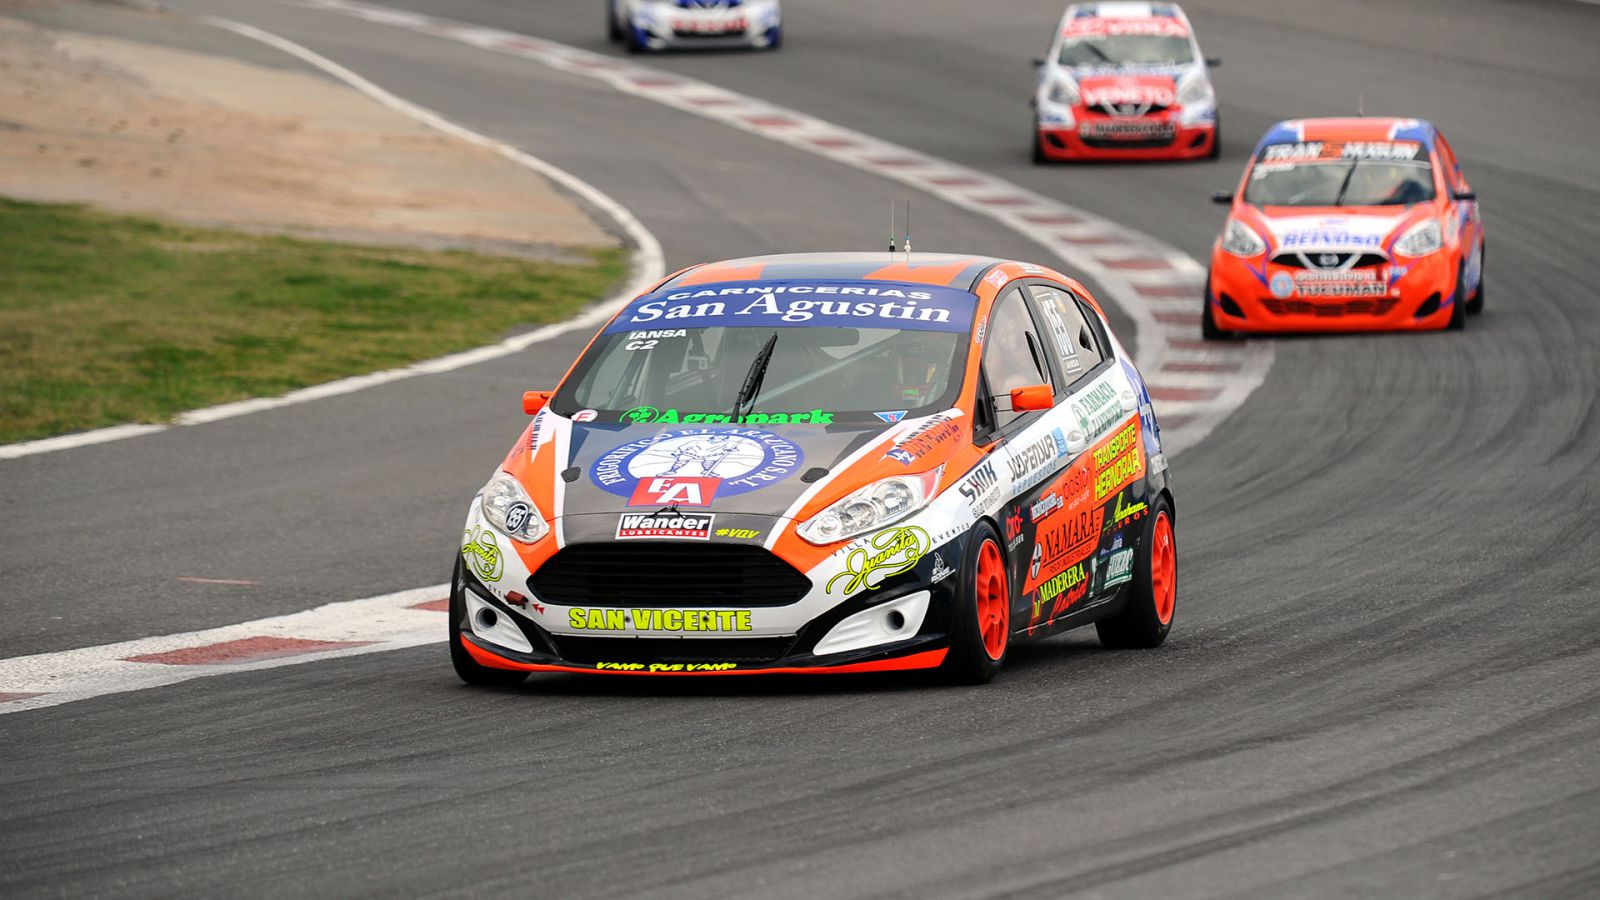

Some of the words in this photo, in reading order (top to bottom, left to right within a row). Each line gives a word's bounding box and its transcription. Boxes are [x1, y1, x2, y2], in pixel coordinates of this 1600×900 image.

[667, 286, 932, 301] CARNICERIAS
[1296, 283, 1386, 297] TUCUMAN
[631, 301, 727, 324] San
[735, 292, 952, 324] Agustin
[625, 340, 656, 351] C2
[629, 329, 687, 340] IANSA
[1079, 381, 1117, 415] FARMACIA
[650, 408, 834, 425] Agropark
[597, 432, 669, 487] FRIGORIFICO
[681, 428, 717, 436] EL
[723, 428, 798, 467] ARAUCANO
[1093, 423, 1137, 470] TRANSPORTE
[624, 514, 709, 530] Wander
[932, 523, 970, 544] EVENTOS
[1043, 507, 1096, 563] NAMARA
[831, 538, 871, 558] VILLA
[826, 526, 931, 595] Juanita
[1039, 562, 1086, 603] MADERERA
[568, 608, 626, 631] SAN
[632, 608, 752, 632] VICENTE
